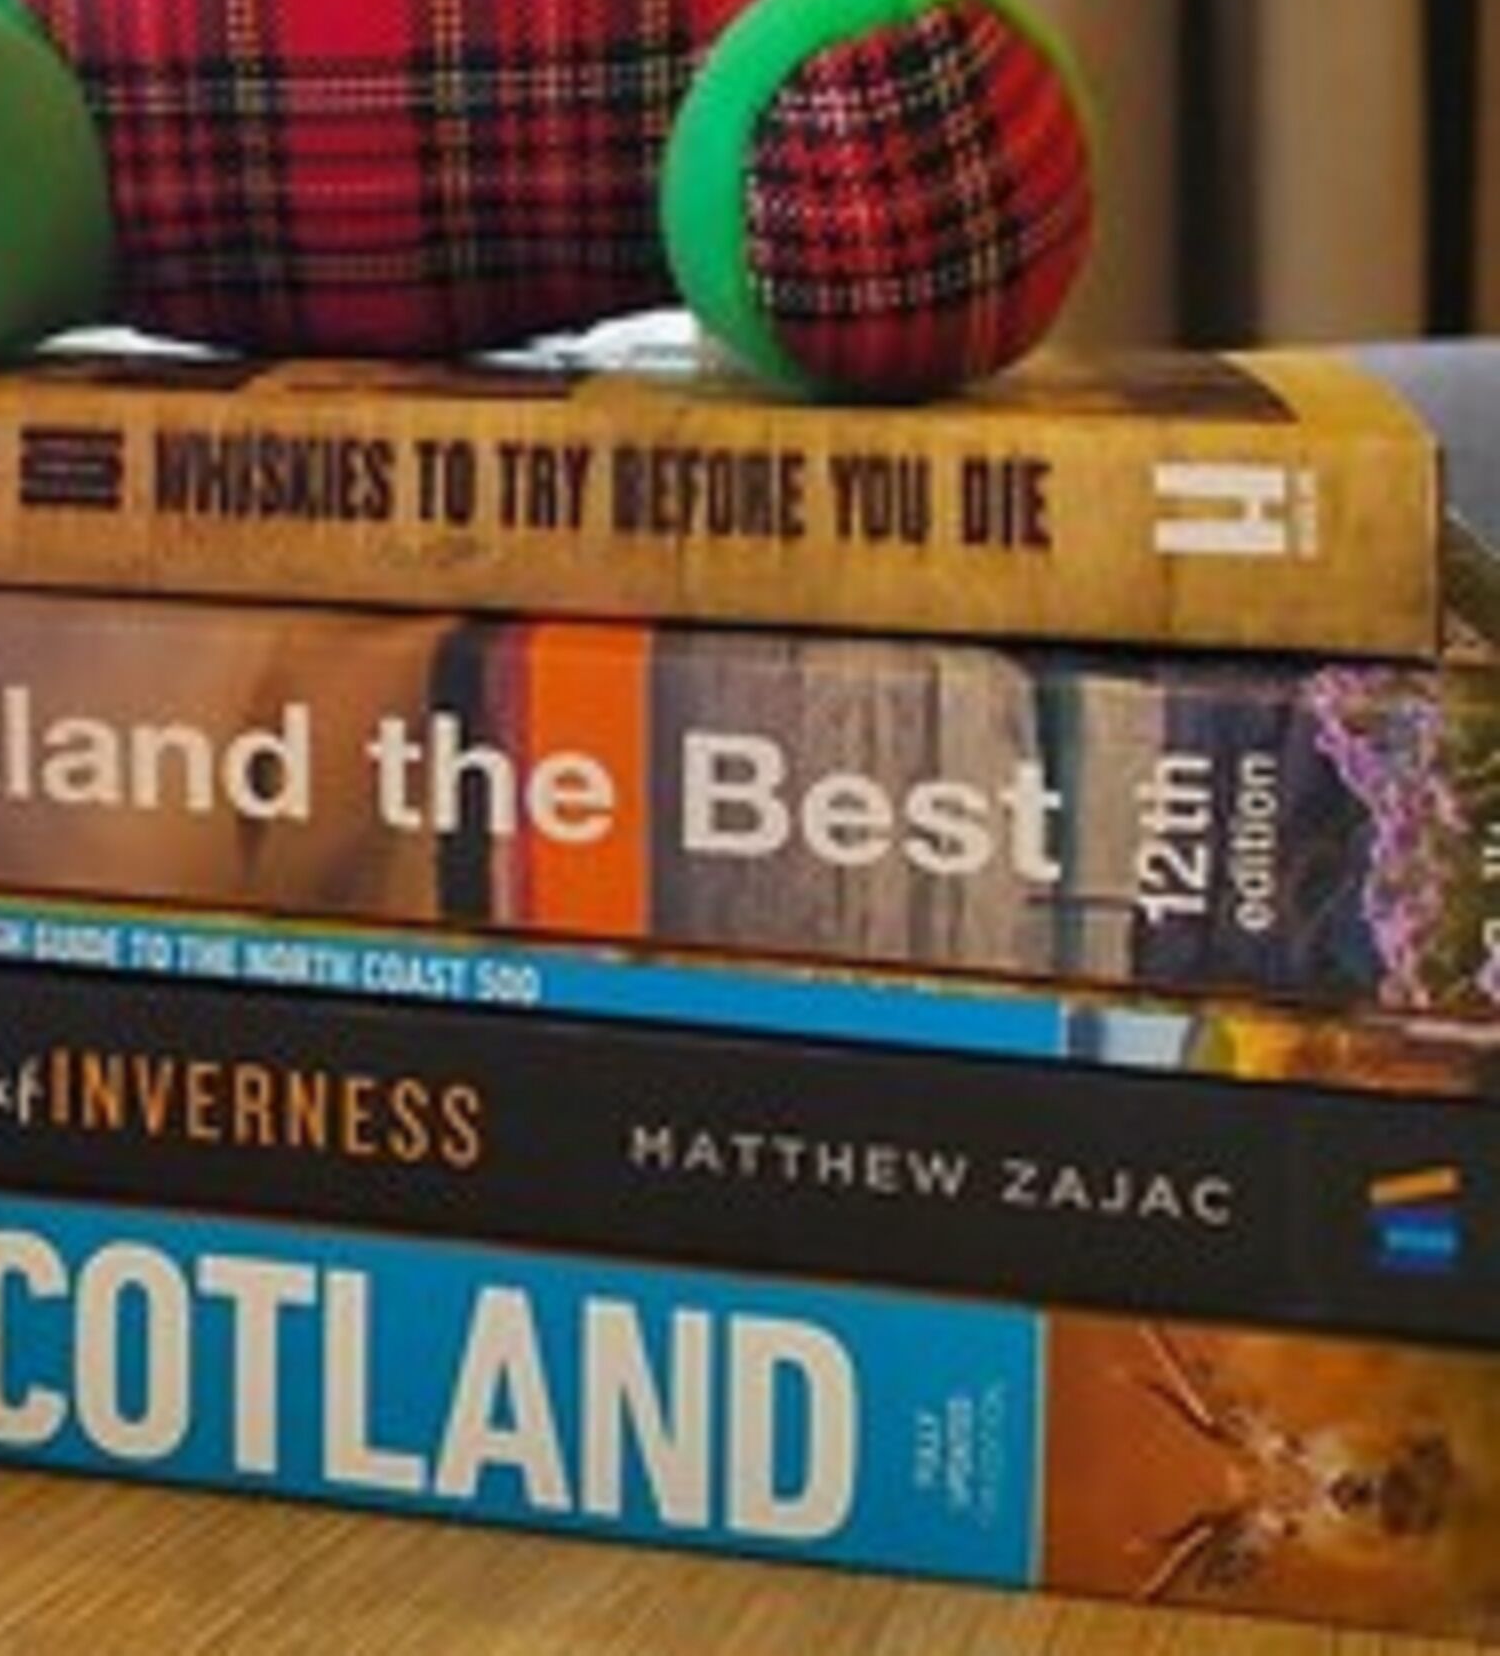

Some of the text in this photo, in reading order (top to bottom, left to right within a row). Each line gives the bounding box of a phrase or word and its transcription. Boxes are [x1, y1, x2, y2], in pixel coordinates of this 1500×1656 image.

[155, 427, 394, 522] WHISKIES
[417, 440, 476, 523] TO
[499, 442, 590, 531] TRY
[612, 447, 805, 537] BEFORE
[826, 454, 932, 544] YOU
[961, 459, 1053, 549] DIE
[365, 710, 616, 845] the
[681, 730, 1062, 883] Best
[1137, 752, 1212, 924] 12th
[1229, 753, 1278, 932] edition
[34, 922, 127, 966] GUIDE
[130, 930, 173, 970] TO
[178, 934, 236, 977] THE
[244, 939, 354, 987] NORTH
[360, 950, 467, 995] COAST
[474, 959, 541, 1004] 500
[48, 1045, 481, 1169] INVERNESS
[628, 1124, 970, 1202] MATTHEW
[1000, 1159, 1234, 1226] ZAJAC
